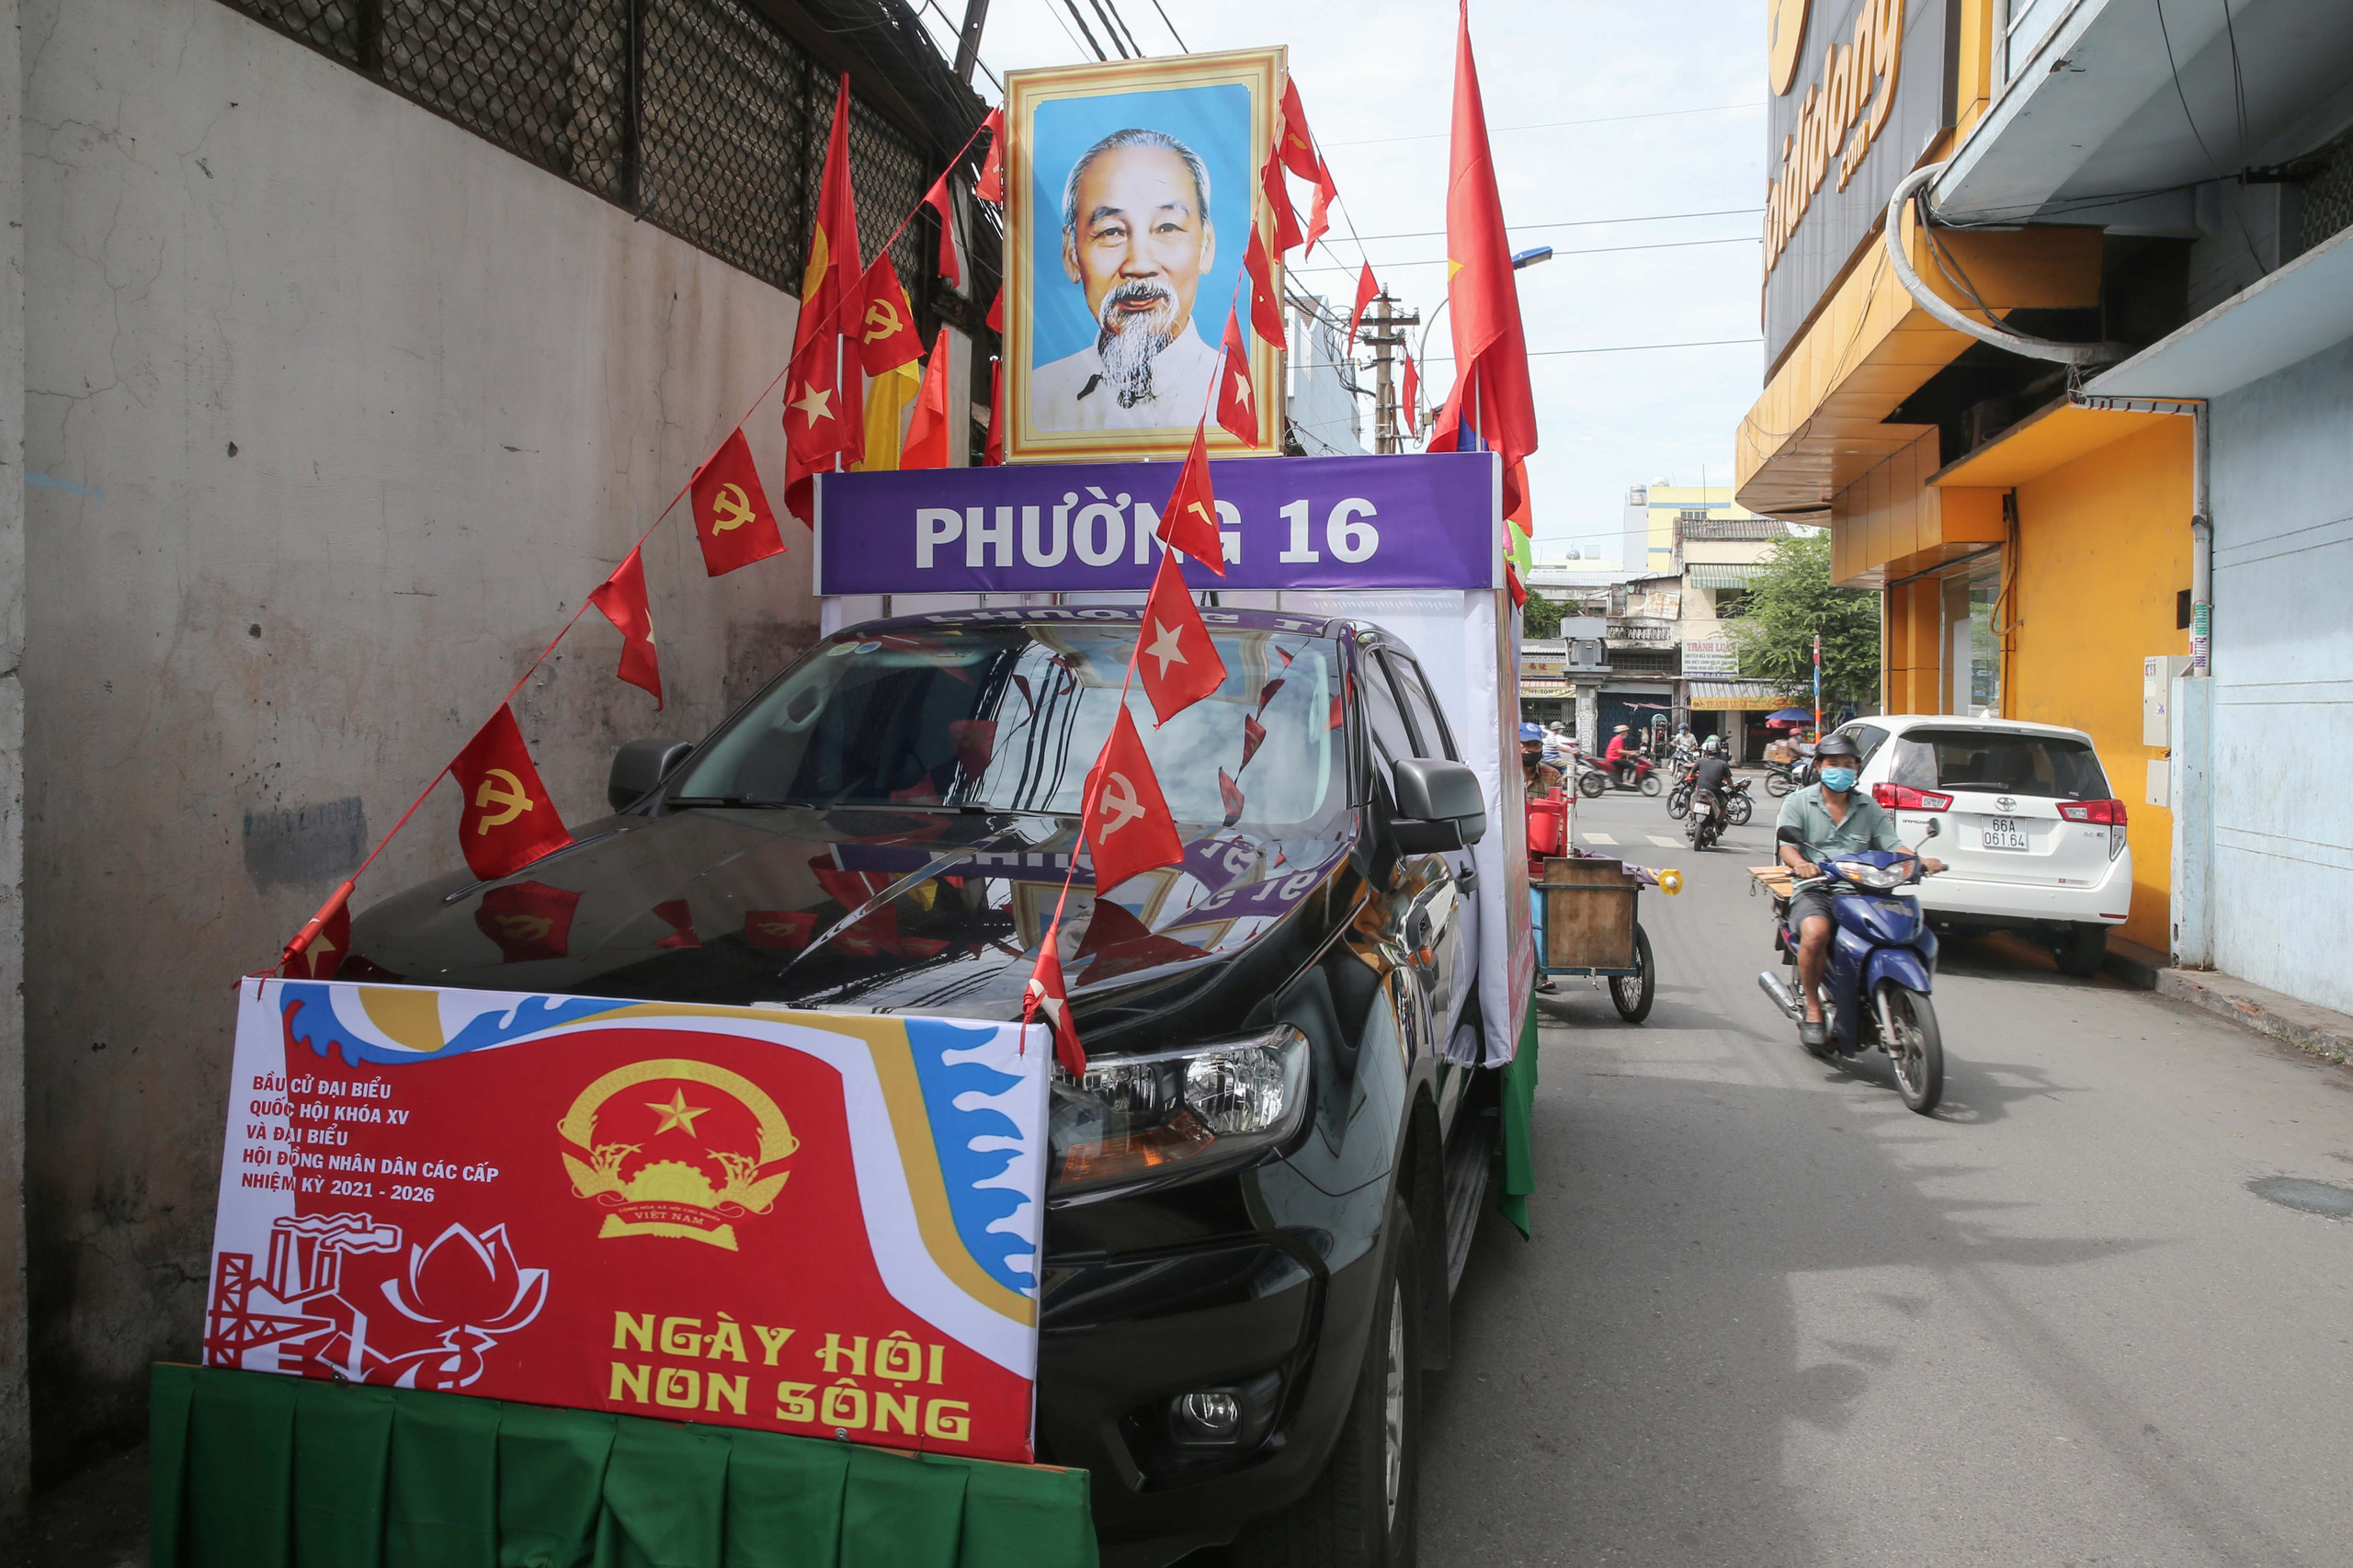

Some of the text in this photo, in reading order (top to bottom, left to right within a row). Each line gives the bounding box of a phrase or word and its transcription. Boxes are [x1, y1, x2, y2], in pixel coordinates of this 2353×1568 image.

[1278, 497, 1381, 564] 16
[1984, 832, 2026, 847] 061.64
[1992, 818, 2016, 834] 66A
[253, 1071, 392, 1099] BẦU CỬ ĐẠI BIỂU
[250, 1096, 410, 1125] QUỐC HỘI KHÓA XV
[246, 1121, 348, 1146] VÀ ĐẠI BIỂU
[243, 1146, 499, 1183] HỘI ĐỒNG NHÂN DÂN CÁC CẤP
[241, 1171, 296, 1192] NHIỆM
[301, 1175, 325, 1193] KỲ
[330, 1179, 373, 1198] 2021
[390, 1185, 435, 1203] 2026
[634, 1210, 705, 1225] VIỆT NAM
[612, 1311, 946, 1389] NGÀY HỘI
[608, 1362, 970, 1442] NON SÔNG
